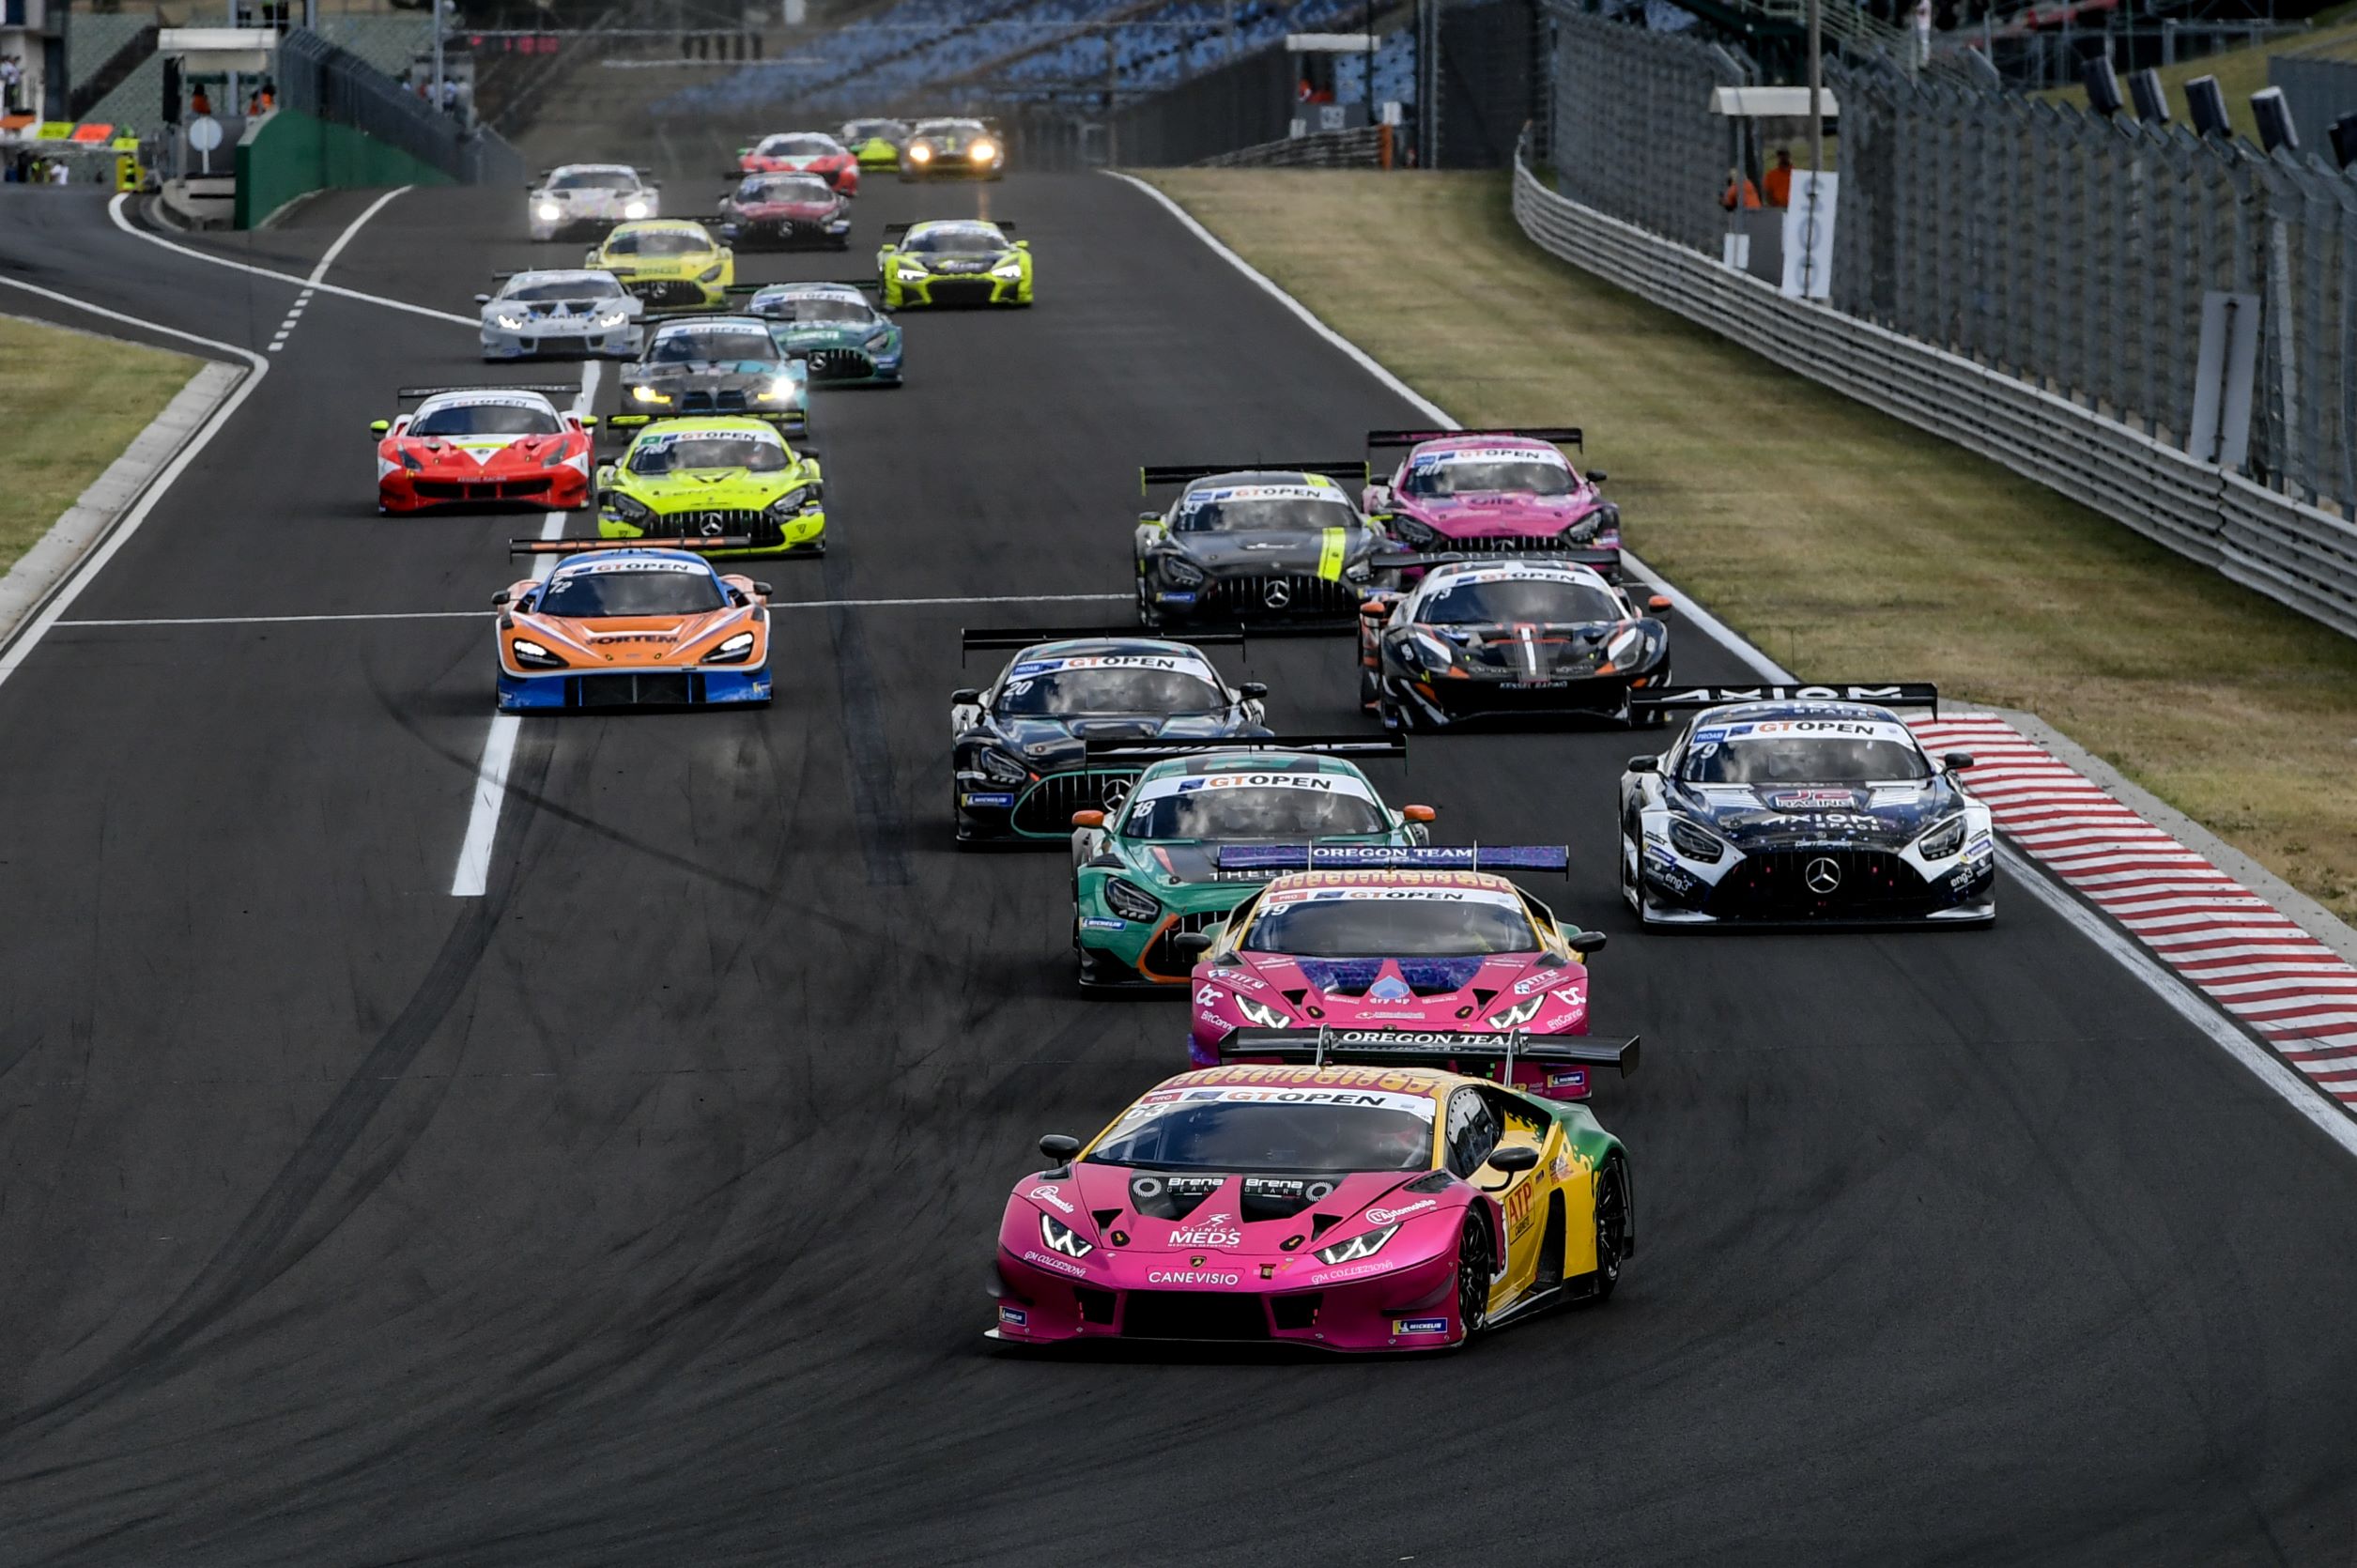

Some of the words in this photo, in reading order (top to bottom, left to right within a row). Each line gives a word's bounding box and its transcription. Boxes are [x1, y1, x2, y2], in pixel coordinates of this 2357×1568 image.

[1002, 680, 1034, 698] 20
[1131, 800, 1156, 819] 18
[1761, 814, 1878, 825] AXIOM
[1313, 848, 1409, 858] OREGON
[1412, 848, 1473, 858] TEAM
[1259, 903, 1289, 917] 19
[1343, 1032, 1454, 1045] OREGON
[1150, 1094, 1173, 1102] PRO
[1124, 1103, 1170, 1120] 63
[1168, 1177, 1225, 1186] Brena
[1245, 1178, 1303, 1189] Brena
[1244, 1187, 1302, 1196] GEARS
[1508, 1182, 1533, 1228] ATP
[1169, 1231, 1241, 1245] MEDS
[1148, 1270, 1240, 1285] CANEVISIO
